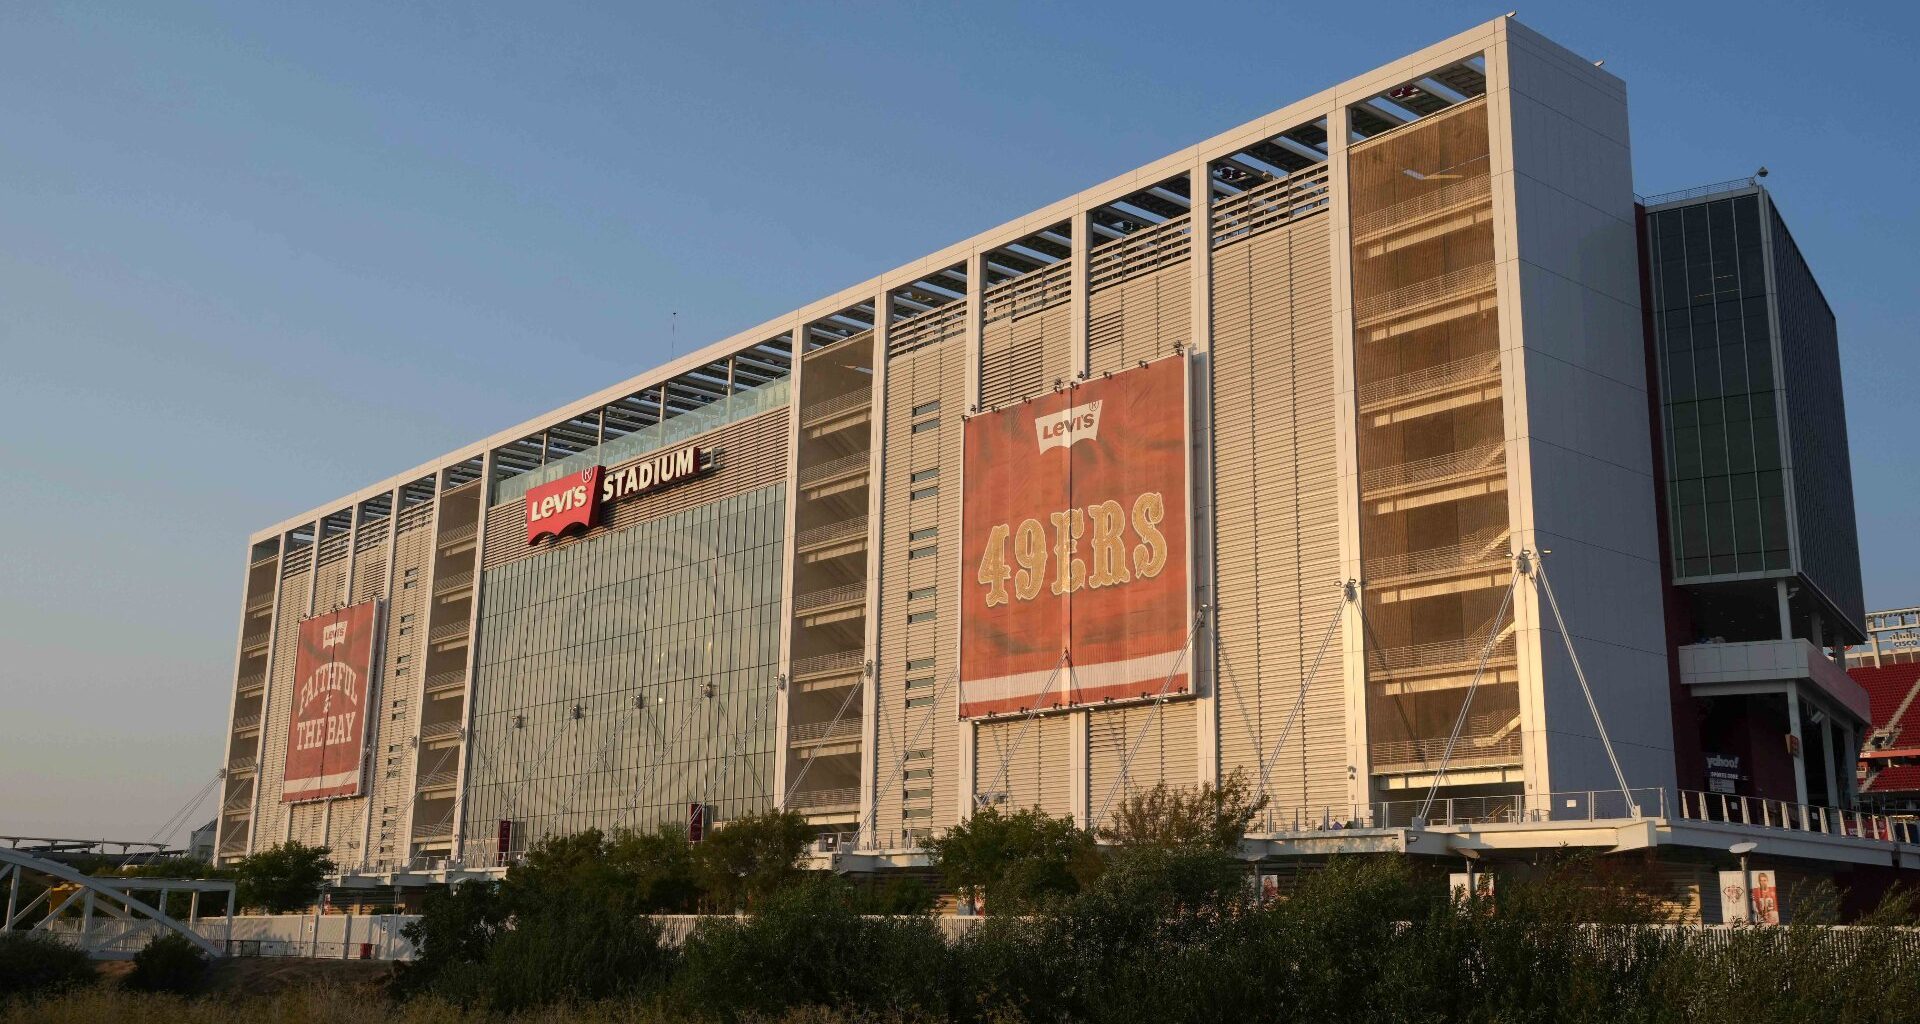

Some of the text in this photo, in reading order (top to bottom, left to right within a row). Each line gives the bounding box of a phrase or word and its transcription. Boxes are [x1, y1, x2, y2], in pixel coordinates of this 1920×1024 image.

[602, 446, 695, 502] STADIUM
[977, 491, 1168, 608] 49ERS
[1893, 639, 1919, 648] CISCO
[298, 661, 358, 717] FAITHFUL
[297, 711, 357, 751] THE BAY
[1706, 754, 1740, 769] yahoo!
